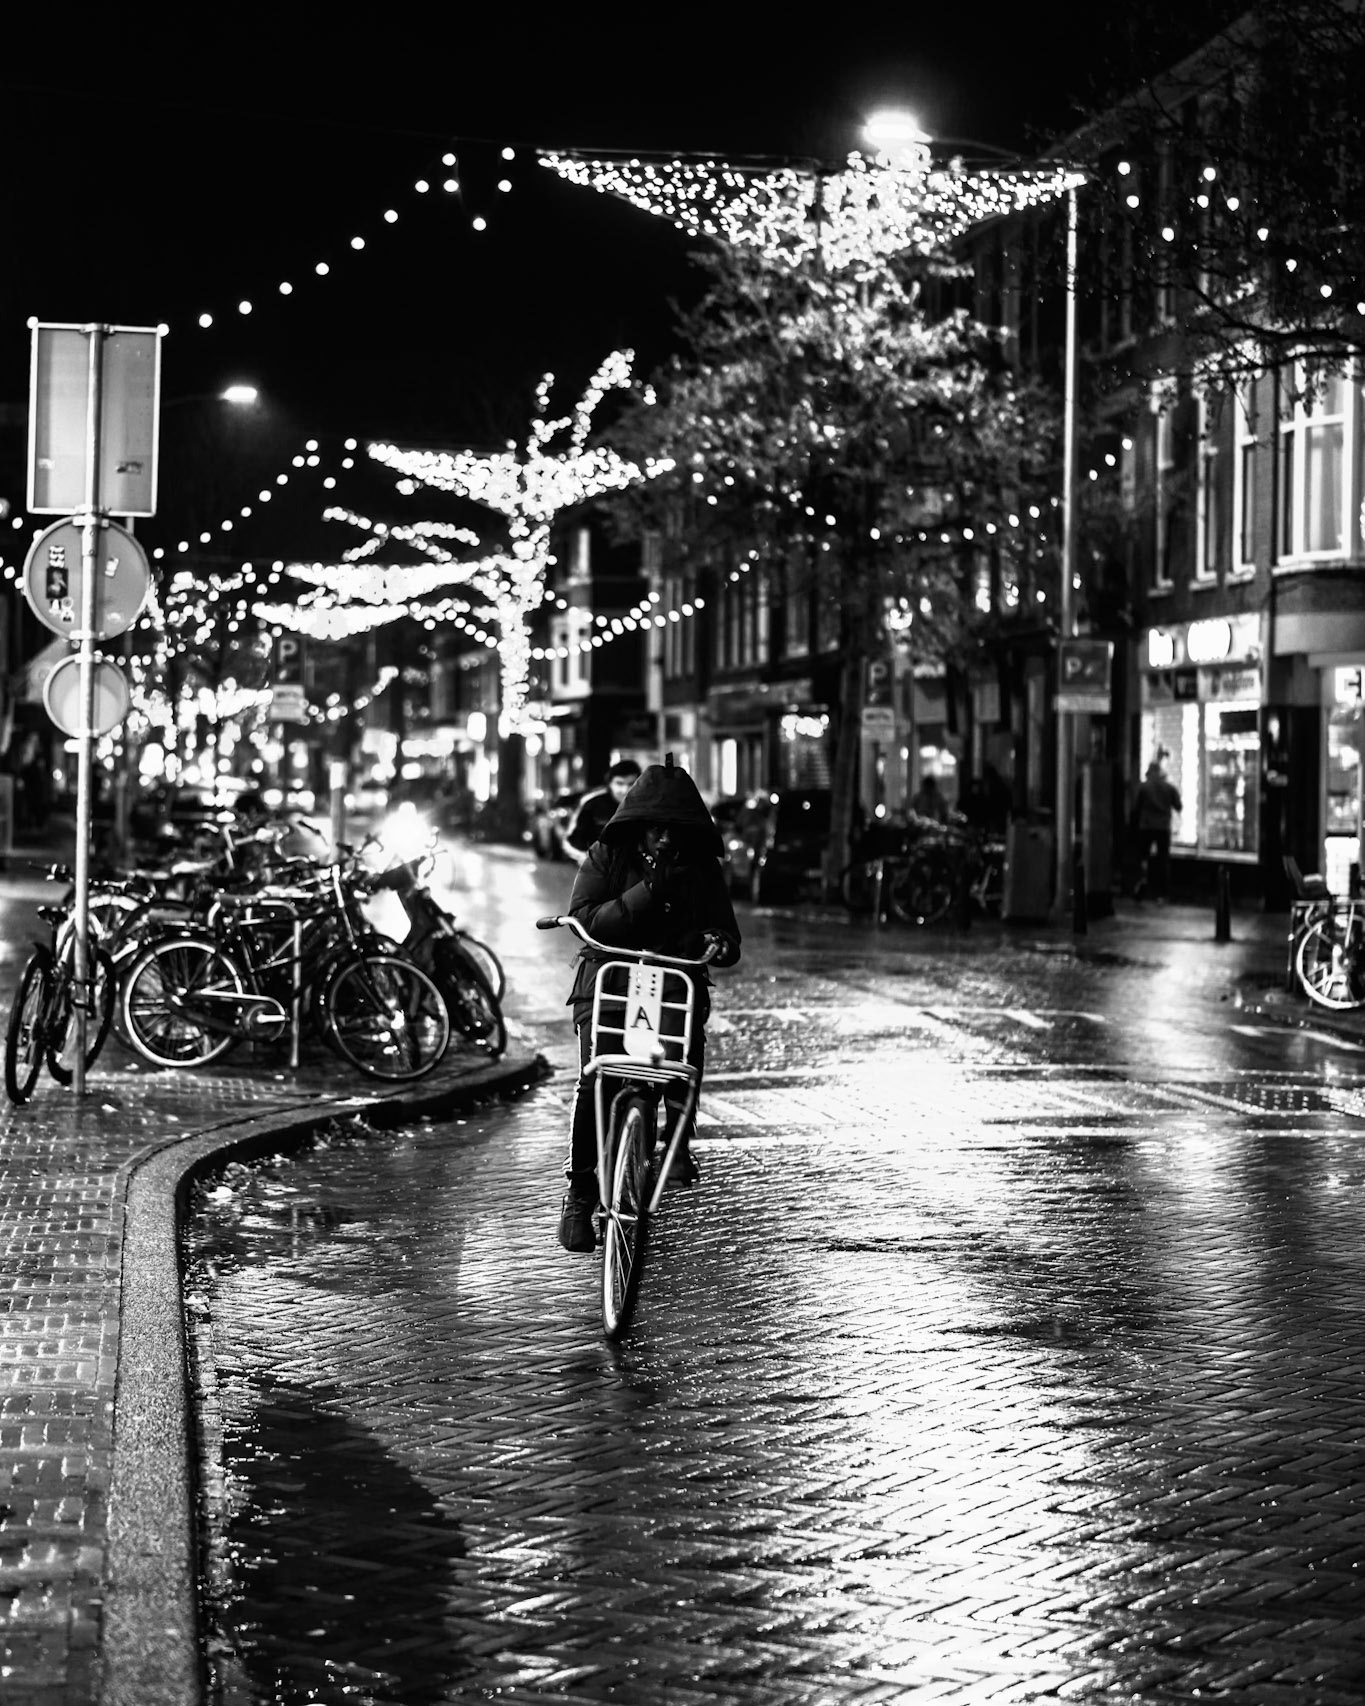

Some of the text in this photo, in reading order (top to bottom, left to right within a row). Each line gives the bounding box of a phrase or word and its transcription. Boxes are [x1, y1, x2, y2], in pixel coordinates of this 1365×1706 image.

[279, 640, 297, 662] P
[870, 662, 886, 686] P
[1066, 657, 1082, 679] P
[630, 1005, 655, 1031] A
